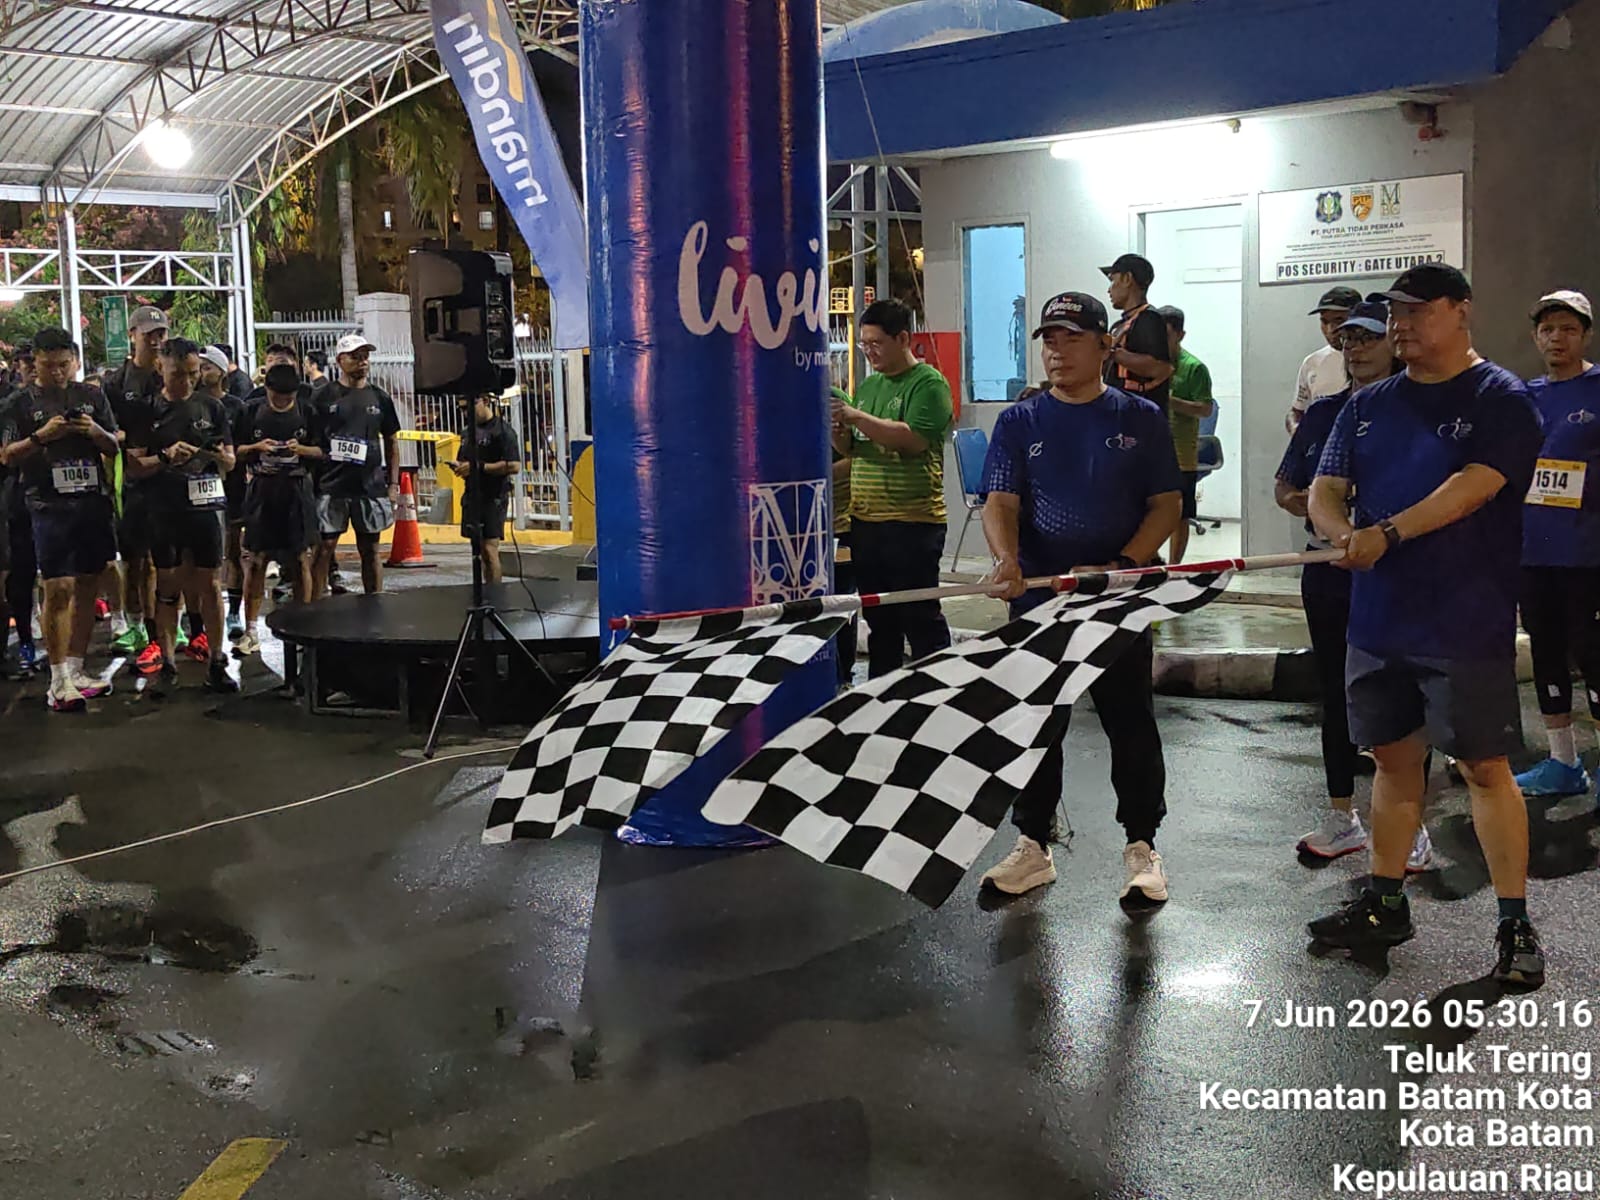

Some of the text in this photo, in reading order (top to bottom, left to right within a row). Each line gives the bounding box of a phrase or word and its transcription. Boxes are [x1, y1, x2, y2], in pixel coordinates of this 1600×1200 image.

[1322, 227, 1346, 235] PUTRA
[1370, 222, 1405, 231] PERKASA
[1278, 264, 1299, 278] POS
[1302, 260, 1357, 276] SECURITY
[1364, 258, 1392, 272] GATE
[795, 346, 812, 372] by
[337, 441, 361, 455] 1540
[62, 468, 90, 482] 1046
[1536, 470, 1568, 490] 1514
